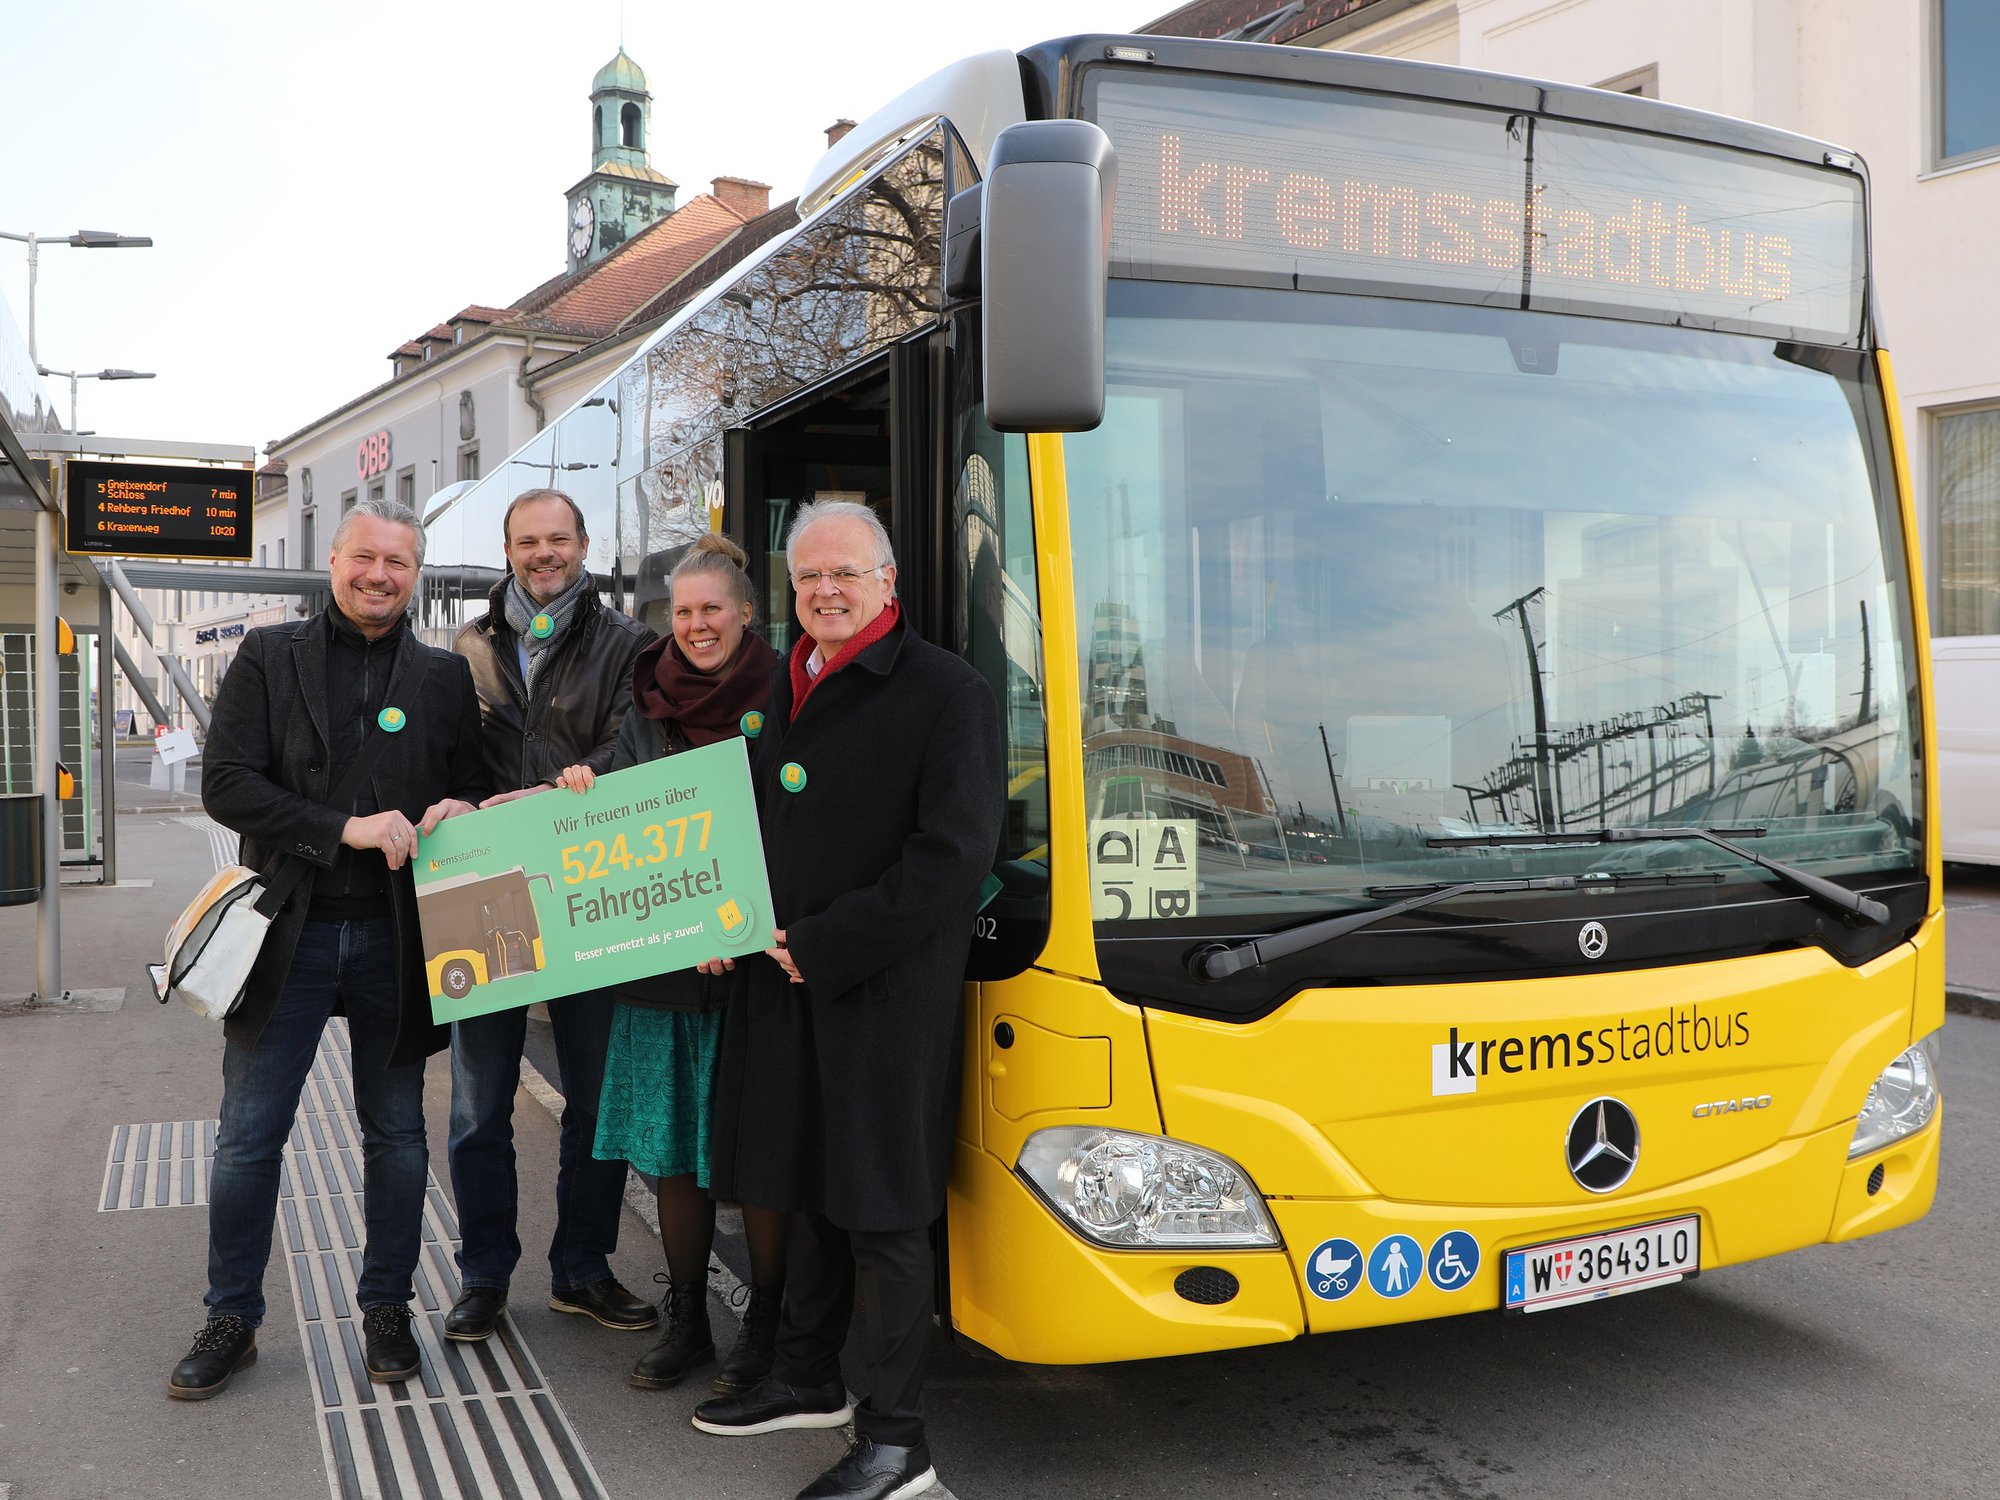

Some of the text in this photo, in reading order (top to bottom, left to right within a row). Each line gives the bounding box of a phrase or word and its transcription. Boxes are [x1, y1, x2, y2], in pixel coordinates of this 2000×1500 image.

[1160, 133, 1793, 300] kremsstadtbus
[356, 431, 390, 479] ÖBB
[97, 480, 168, 494] 5 Gneixendorf
[107, 489, 146, 500] Schloss
[211, 489, 237, 500] 7 min
[97, 502, 192, 517] 4 Rehberg Friedhof
[206, 507, 237, 518] 10 min
[97, 521, 160, 534] 6 Kraxenweg
[210, 526, 236, 536] 10:20
[553, 784, 699, 835] Wir freuen uns über
[431, 845, 491, 869] kremsstadtbus
[561, 810, 713, 885] 524.377
[1097, 830, 1133, 864] D
[1154, 826, 1185, 864] A
[566, 858, 723, 927] Fahrgäste!
[1155, 890, 1191, 918] B
[972, 916, 997, 940] 02
[574, 922, 704, 962] Besser vernetzt als je zuvor!
[1448, 1004, 1750, 1078] kremsstadtbus
[1692, 1094, 1772, 1119] CITARO
[1532, 1255, 1553, 1293] W
[1512, 1284, 1521, 1296] A
